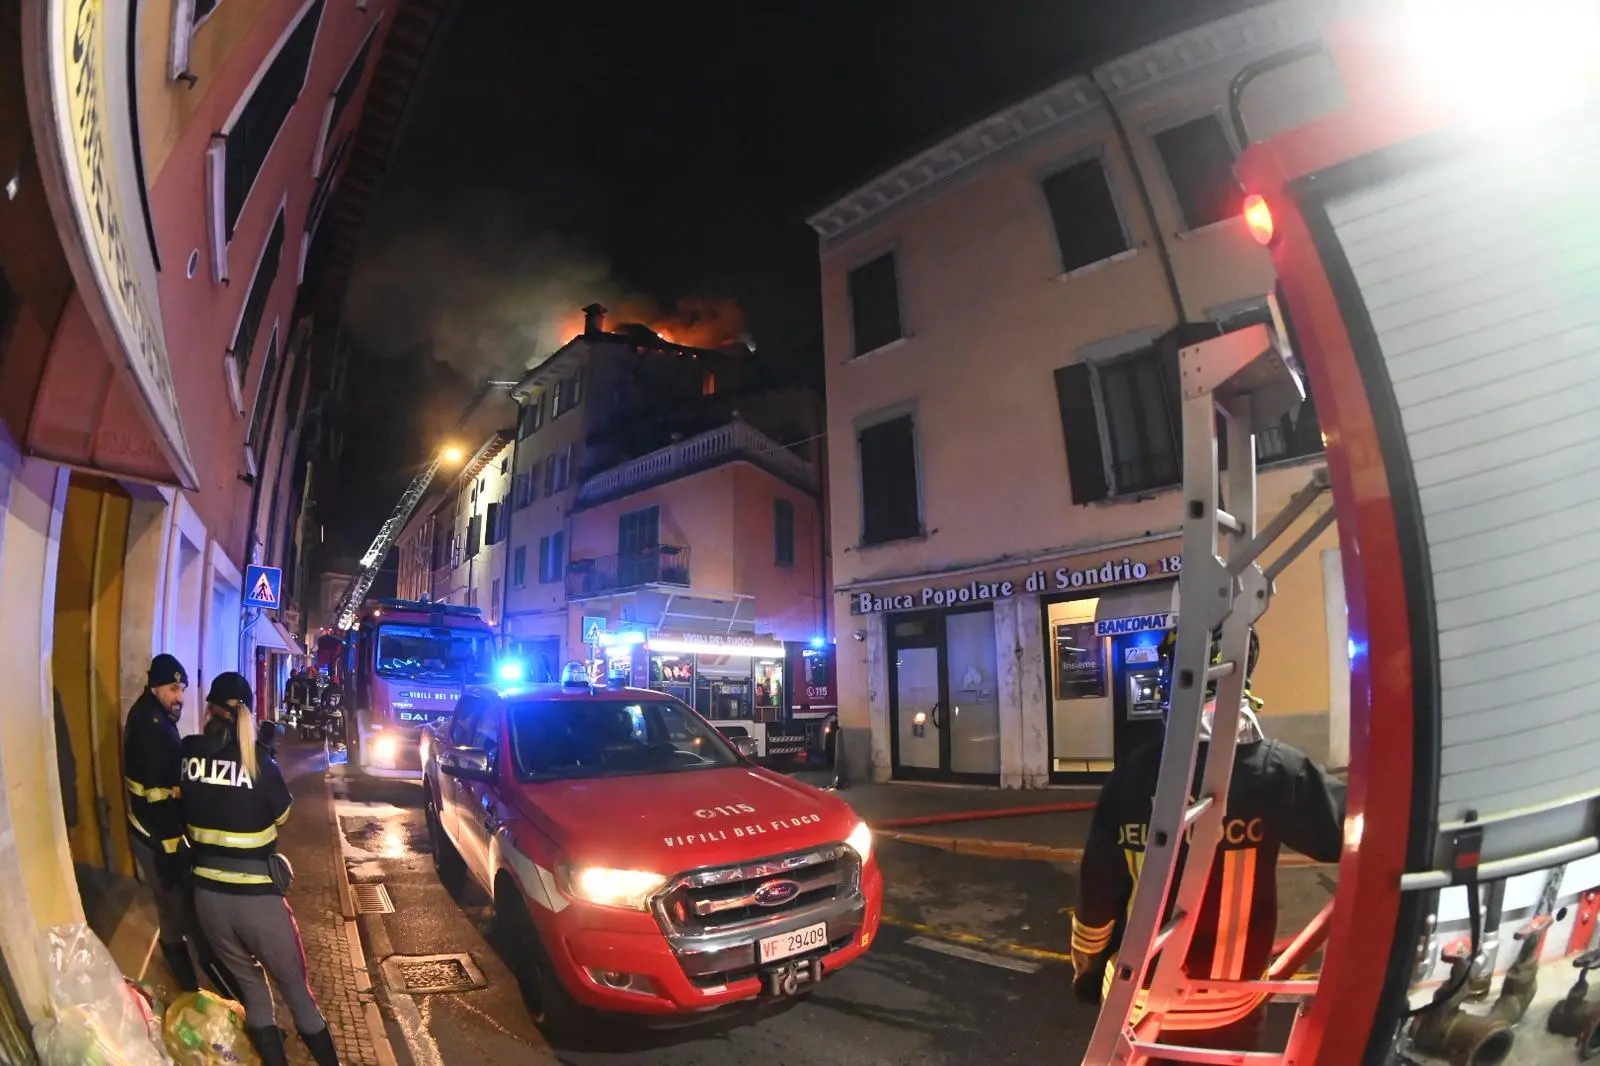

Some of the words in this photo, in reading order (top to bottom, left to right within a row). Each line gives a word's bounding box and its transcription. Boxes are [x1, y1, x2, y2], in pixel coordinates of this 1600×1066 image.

[859, 592, 913, 613] Banca
[921, 581, 1013, 607] Popolare
[1025, 570, 1045, 592] di
[1055, 558, 1147, 589] Sondrio
[1098, 614, 1169, 634] BANCOMAT
[683, 633, 707, 645] VIGILI
[709, 634, 723, 646] DEL
[727, 636, 754, 647] FUOCO
[1063, 660, 1097, 670] Insieme
[409, 691, 431, 699] VIGILI
[815, 686, 828, 696] 115
[400, 712, 428, 721] BAI
[180, 757, 253, 789] POLIZIA
[714, 803, 756, 816] 115
[733, 825, 767, 838] DEL
[763, 940, 779, 957] VF
[788, 927, 824, 951] 29409
